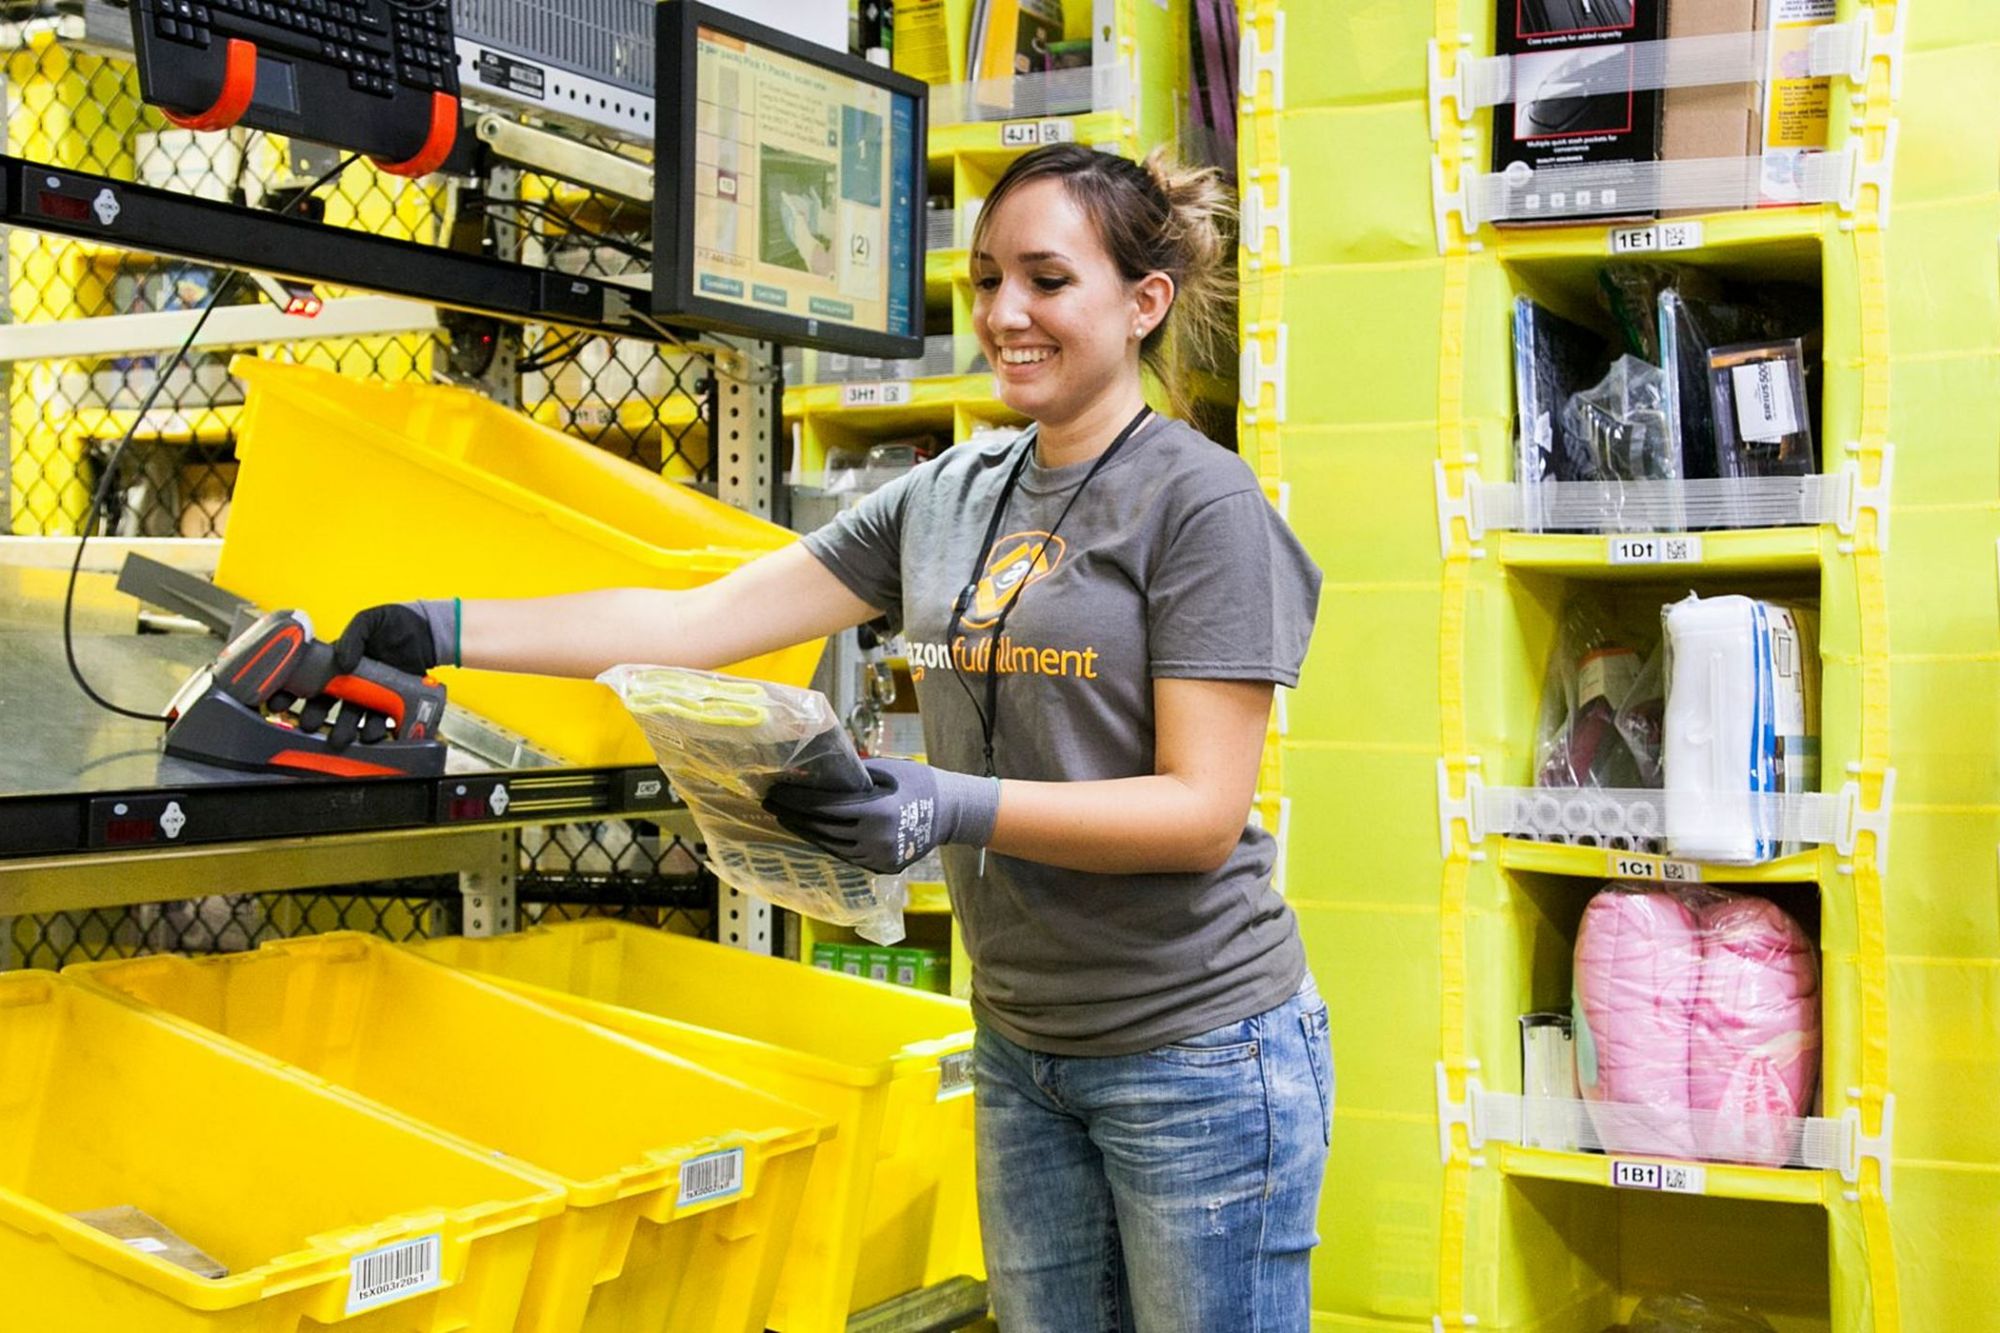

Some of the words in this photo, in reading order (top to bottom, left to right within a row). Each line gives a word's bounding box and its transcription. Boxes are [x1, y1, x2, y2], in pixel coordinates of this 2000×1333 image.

[1619, 232, 1642, 248] 1E
[849, 388, 868, 401] 3H
[1620, 543, 1644, 558] 1D
[1619, 861, 1643, 876] 1C
[1620, 1167, 1645, 1183] 1B
